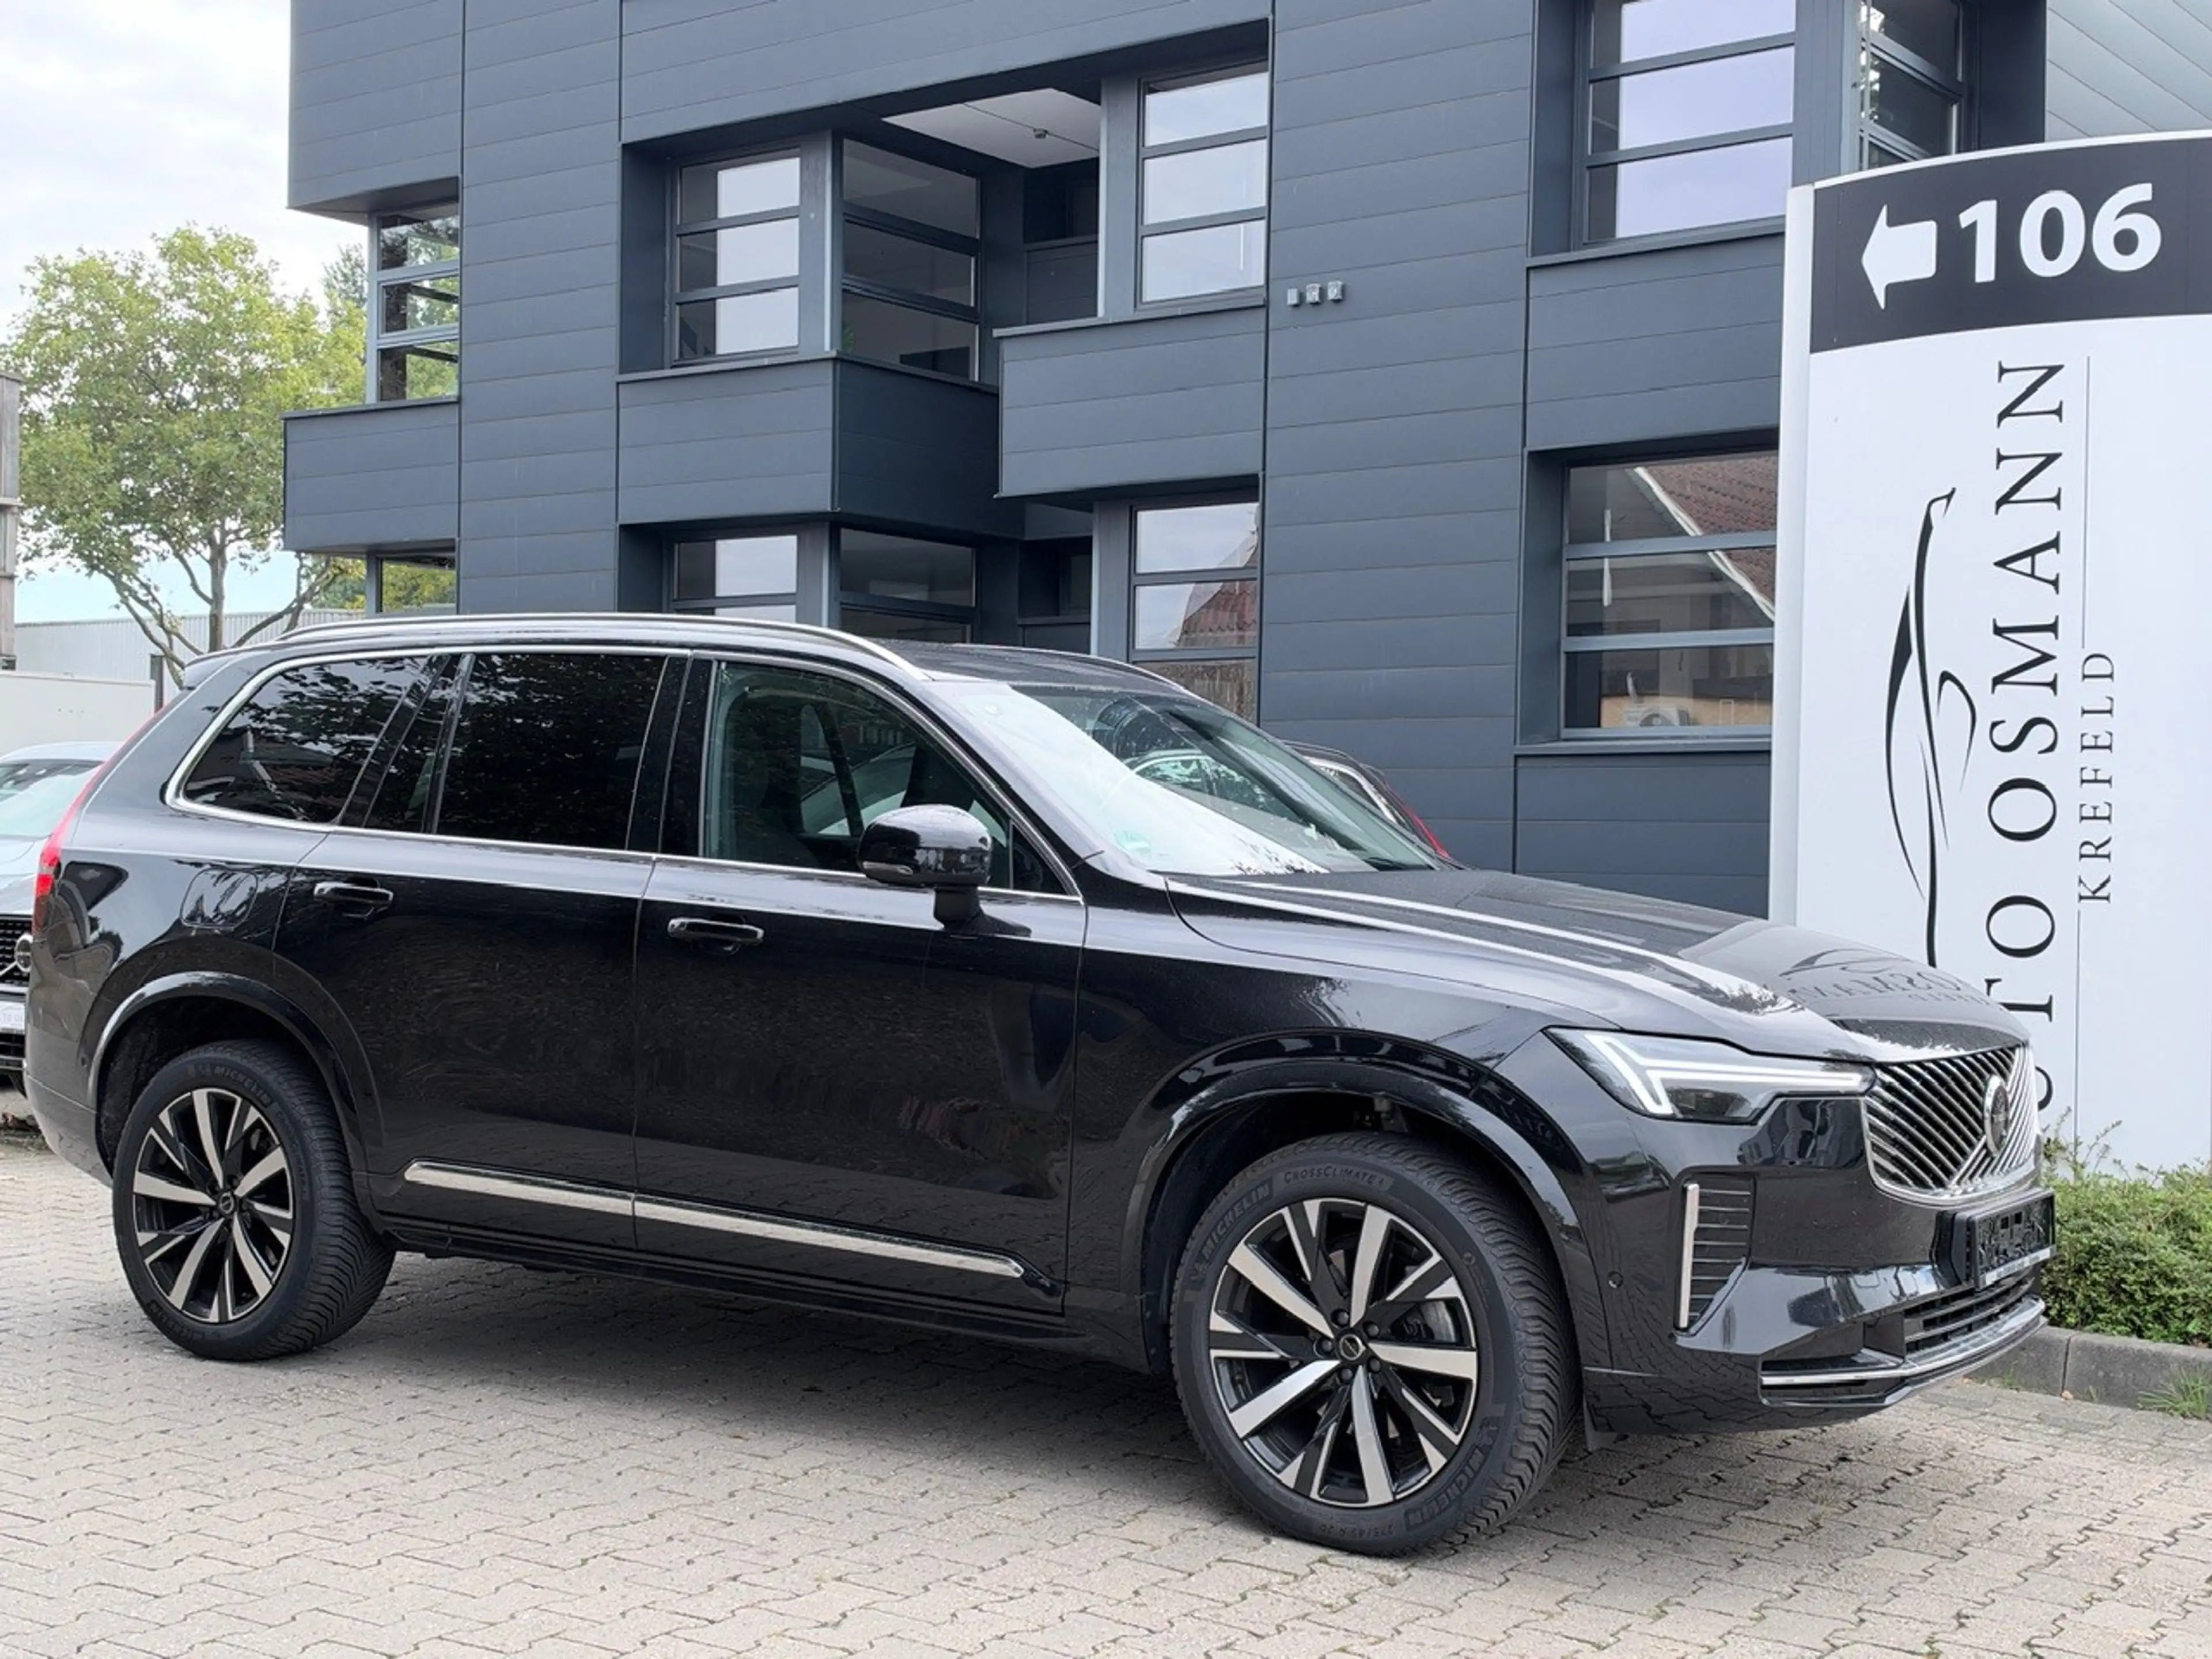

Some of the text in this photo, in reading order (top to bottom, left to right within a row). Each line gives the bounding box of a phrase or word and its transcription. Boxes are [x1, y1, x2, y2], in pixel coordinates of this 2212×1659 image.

[1959, 183, 2161, 283] 106
[1984, 361, 2065, 1111] TO OSMANN
[2078, 653, 2114, 903] KREFELD
[1202, 1183, 1271, 1262] MICHELIN
